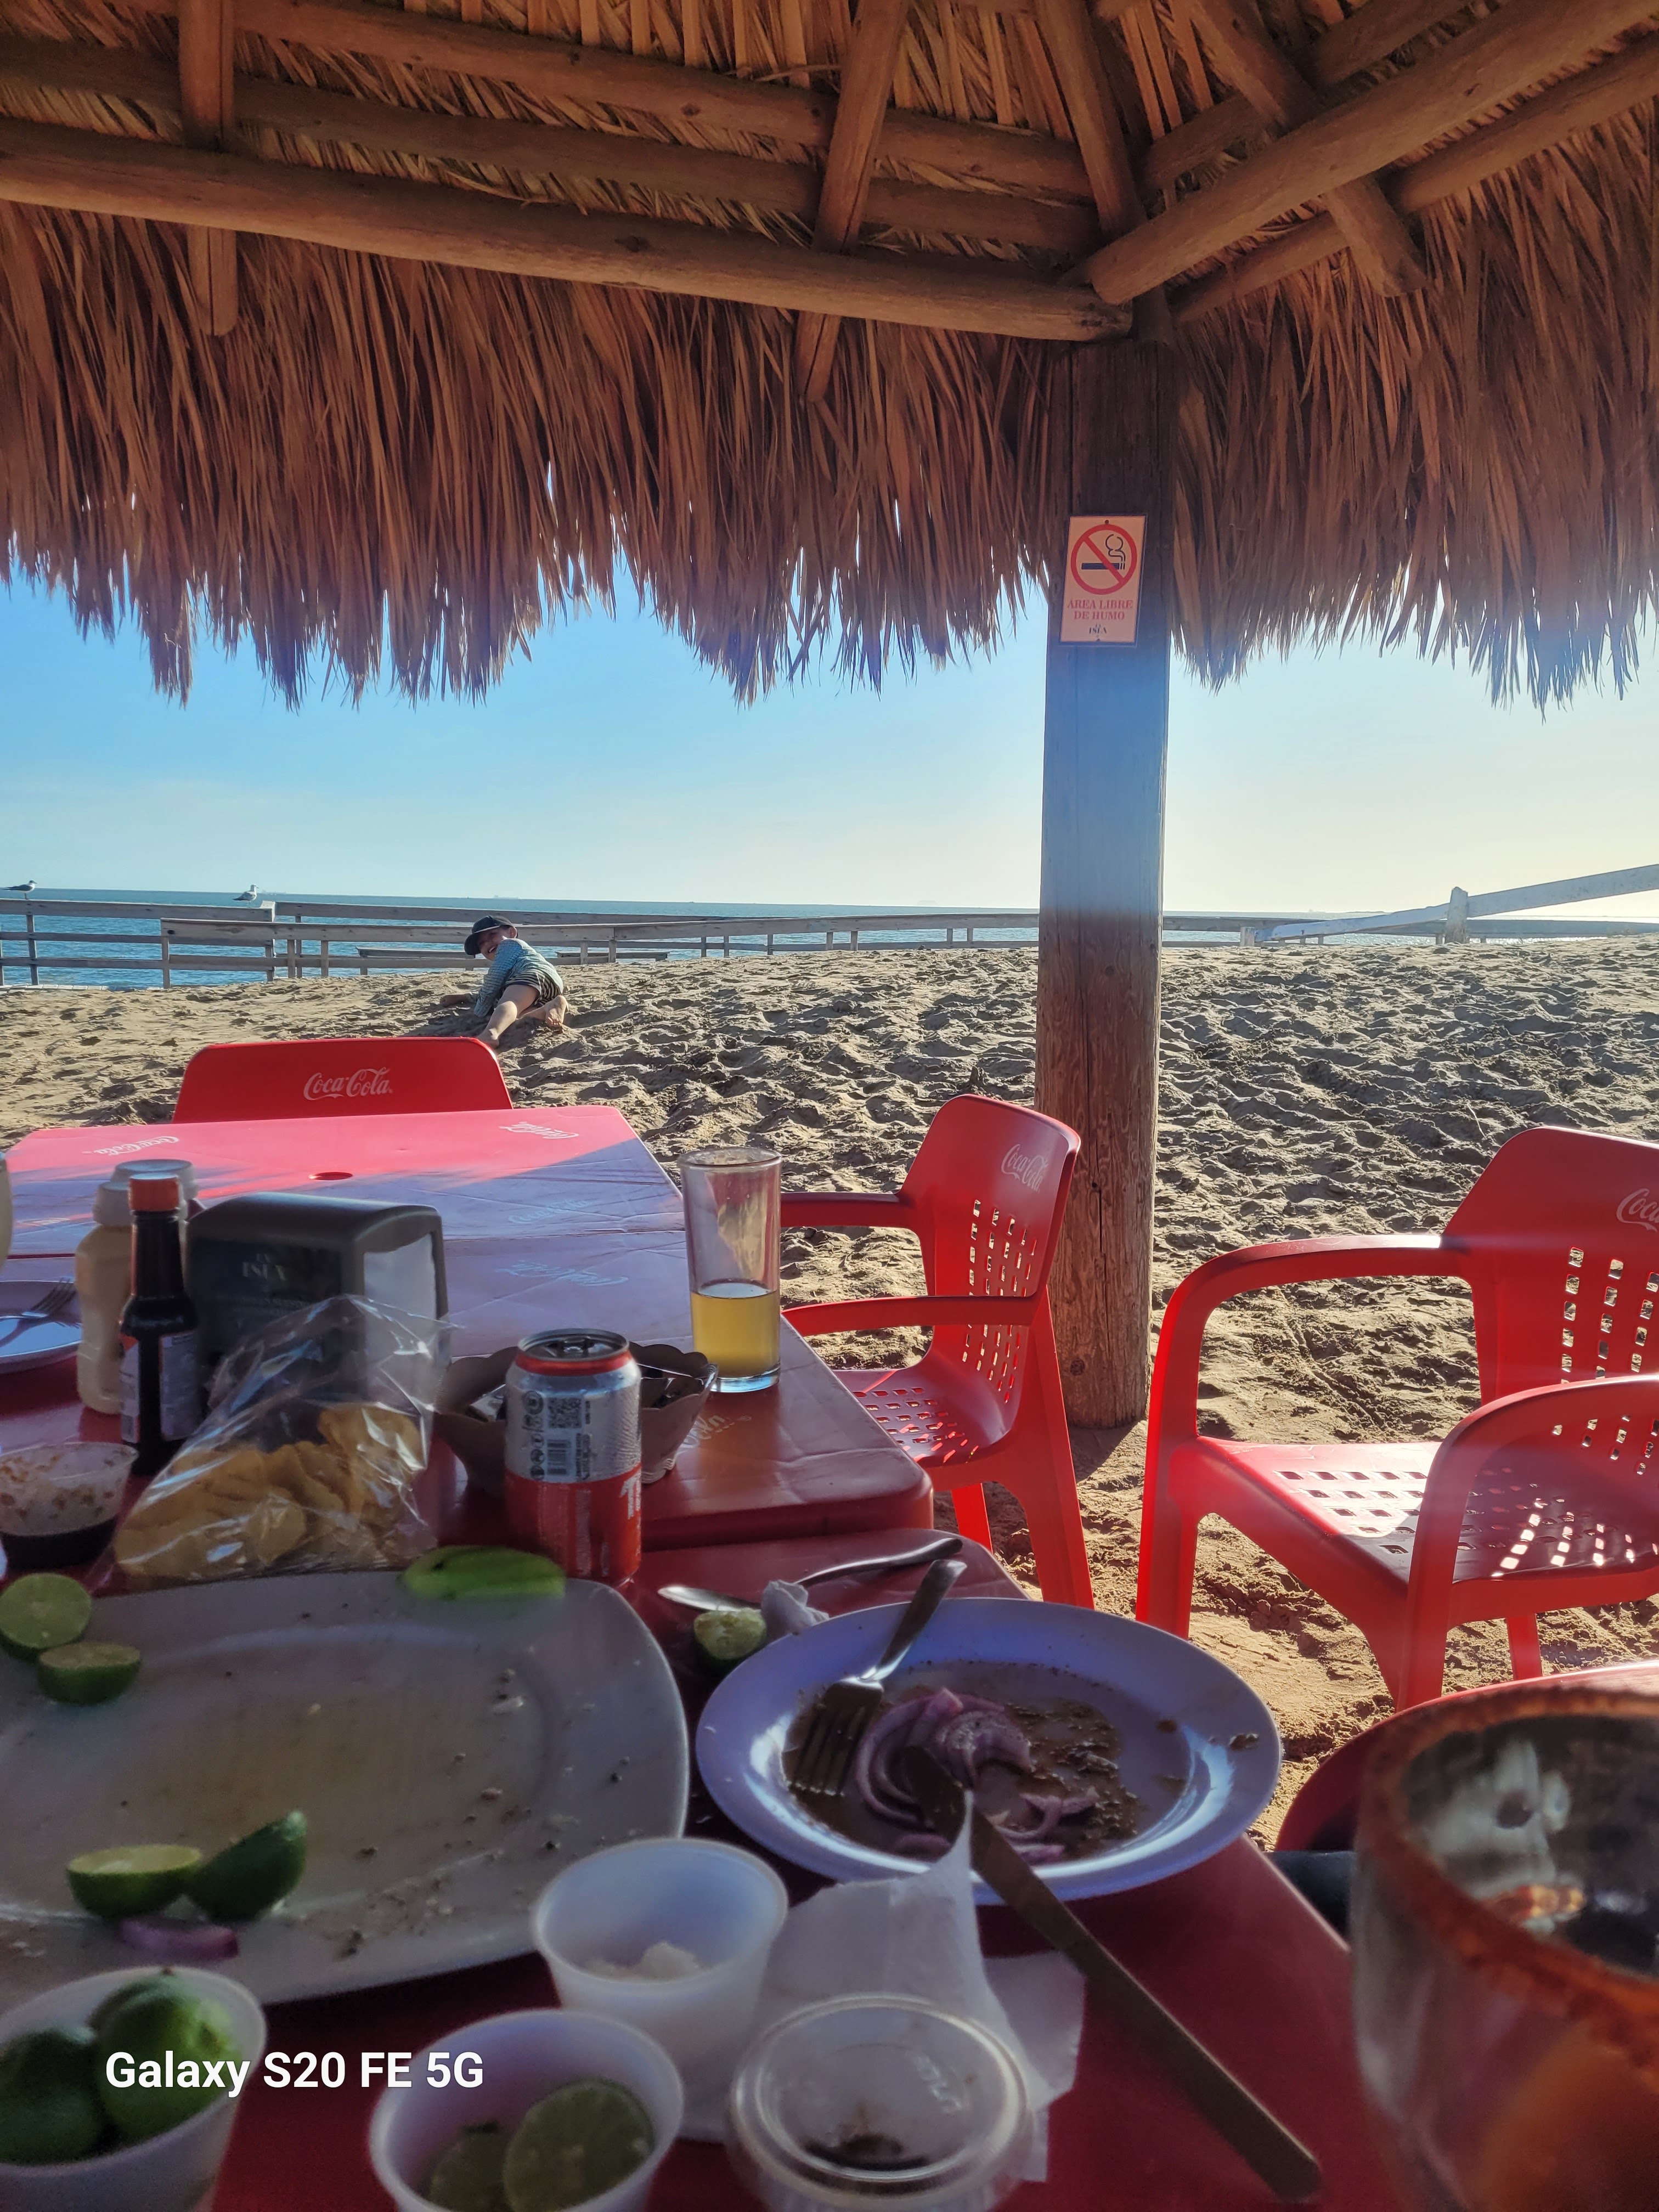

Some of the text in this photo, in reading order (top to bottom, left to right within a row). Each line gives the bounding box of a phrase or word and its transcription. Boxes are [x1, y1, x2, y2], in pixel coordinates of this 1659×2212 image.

[1099, 599, 1133, 610] LIBRE
[1074, 611, 1125, 620] DE HUMO
[303, 1067, 391, 1101] Coca-Cola
[93, 1136, 179, 1156] Coca-Cola
[1001, 1144, 1048, 1193] Coca-Cola
